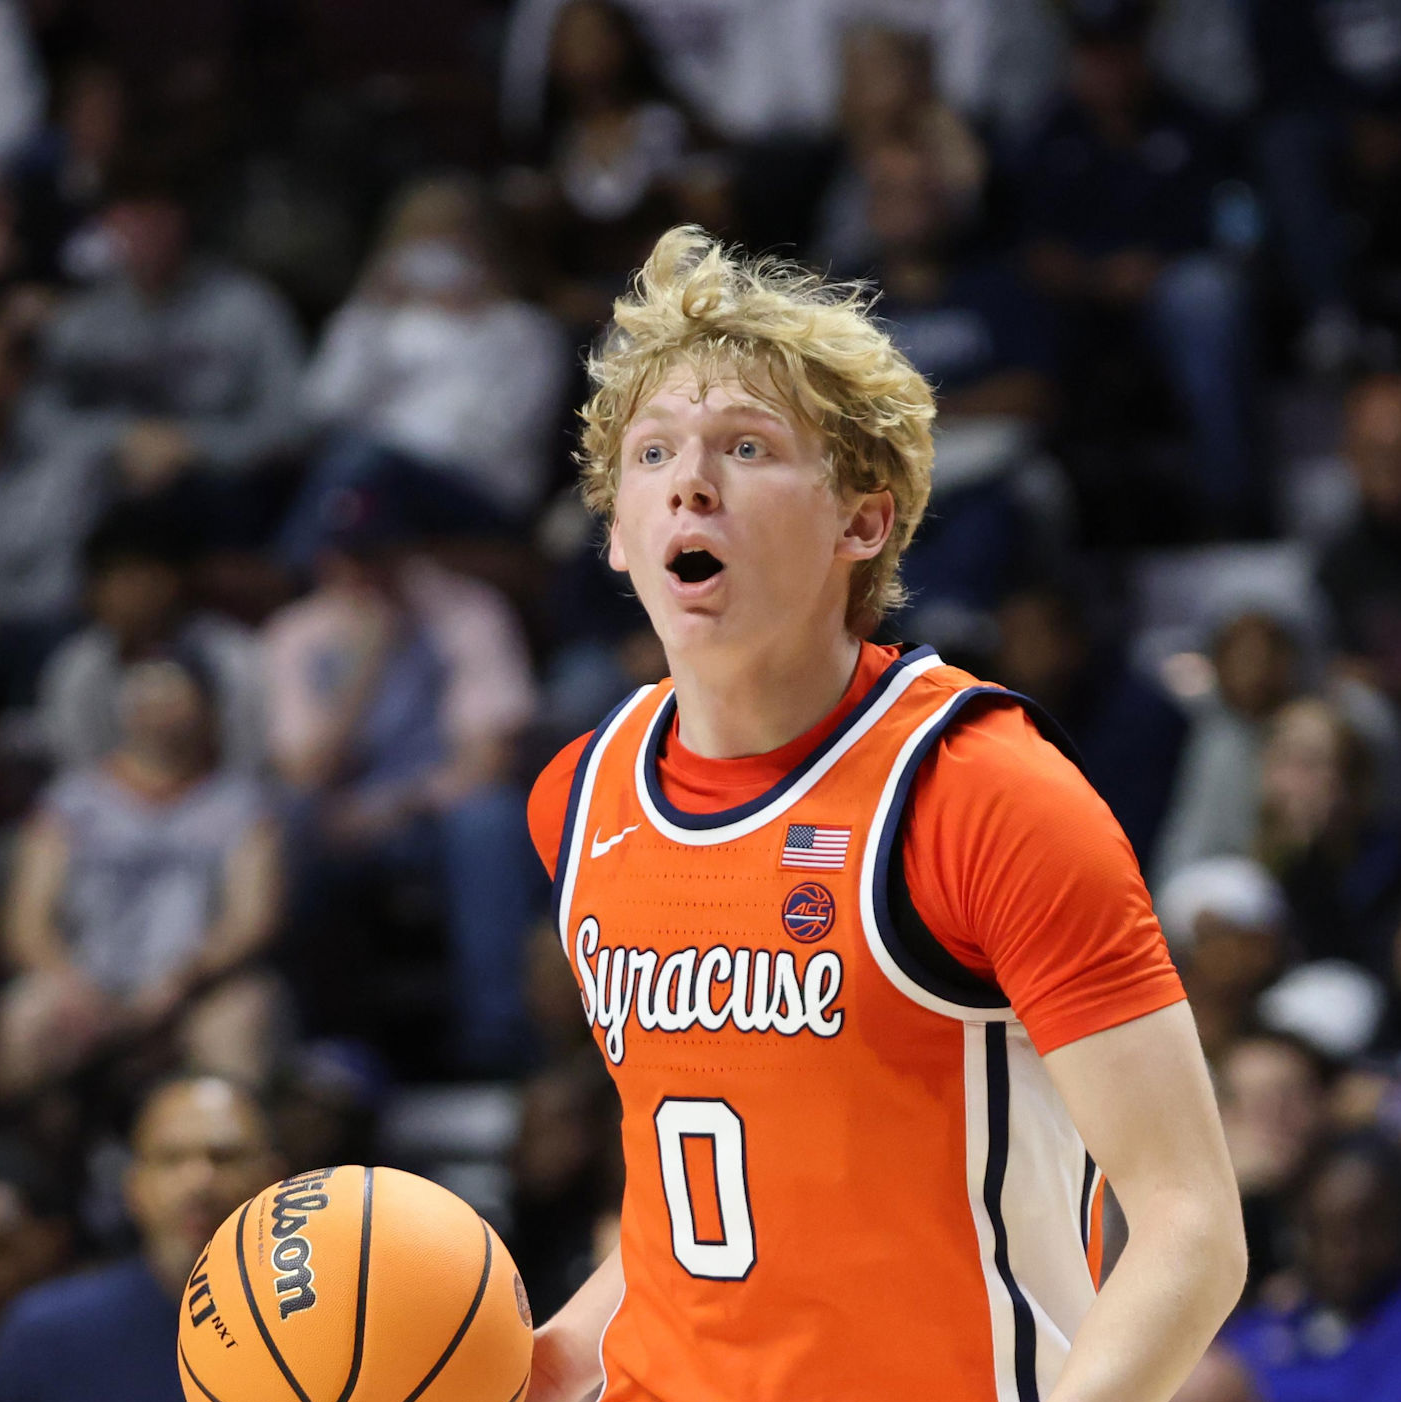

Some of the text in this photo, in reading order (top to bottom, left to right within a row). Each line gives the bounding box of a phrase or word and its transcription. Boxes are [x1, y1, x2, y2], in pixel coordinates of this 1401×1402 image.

[790, 902, 831, 916] ACC
[573, 914, 845, 1066] Syracuse
[654, 1096, 757, 1282] 0
[211, 1316, 239, 1350] NXT
